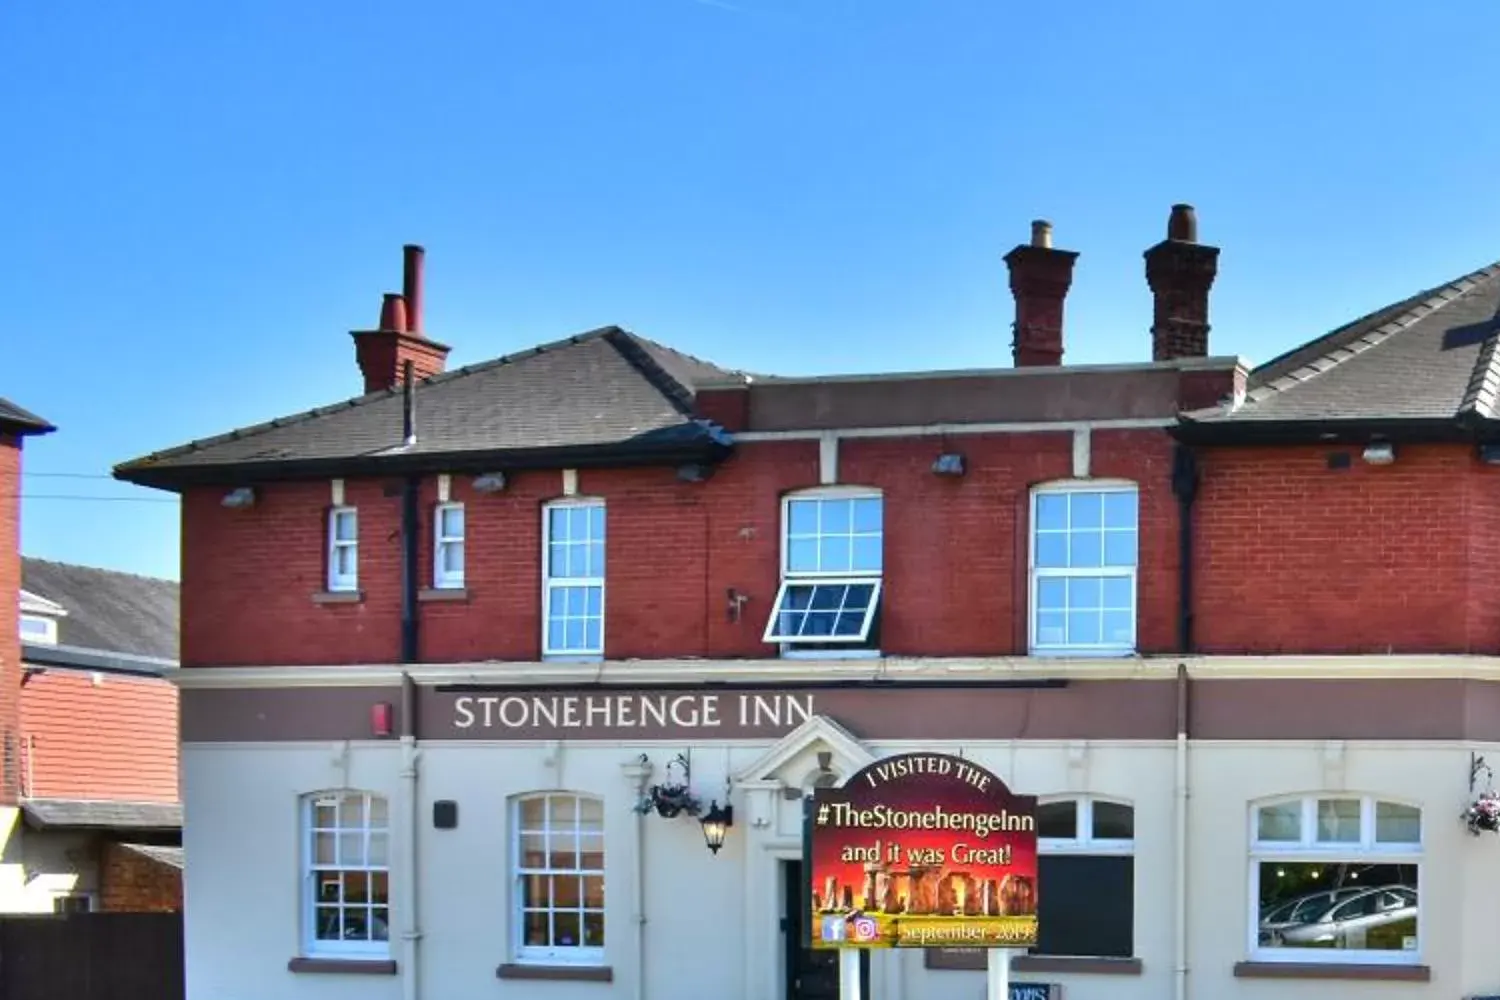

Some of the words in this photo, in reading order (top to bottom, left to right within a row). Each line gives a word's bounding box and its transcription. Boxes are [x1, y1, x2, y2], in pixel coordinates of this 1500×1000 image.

[455, 695, 721, 728] STONEHENGE
[739, 694, 814, 726] INN
[865, 772, 876, 788] I
[876, 757, 951, 782] VISITED
[956, 762, 991, 793] THE
[817, 802, 1035, 838] #TheStonehengeInn
[841, 839, 881, 862] and
[887, 841, 901, 862] it
[906, 848, 946, 864] was
[951, 843, 1012, 865] Great!
[904, 922, 986, 945] September
